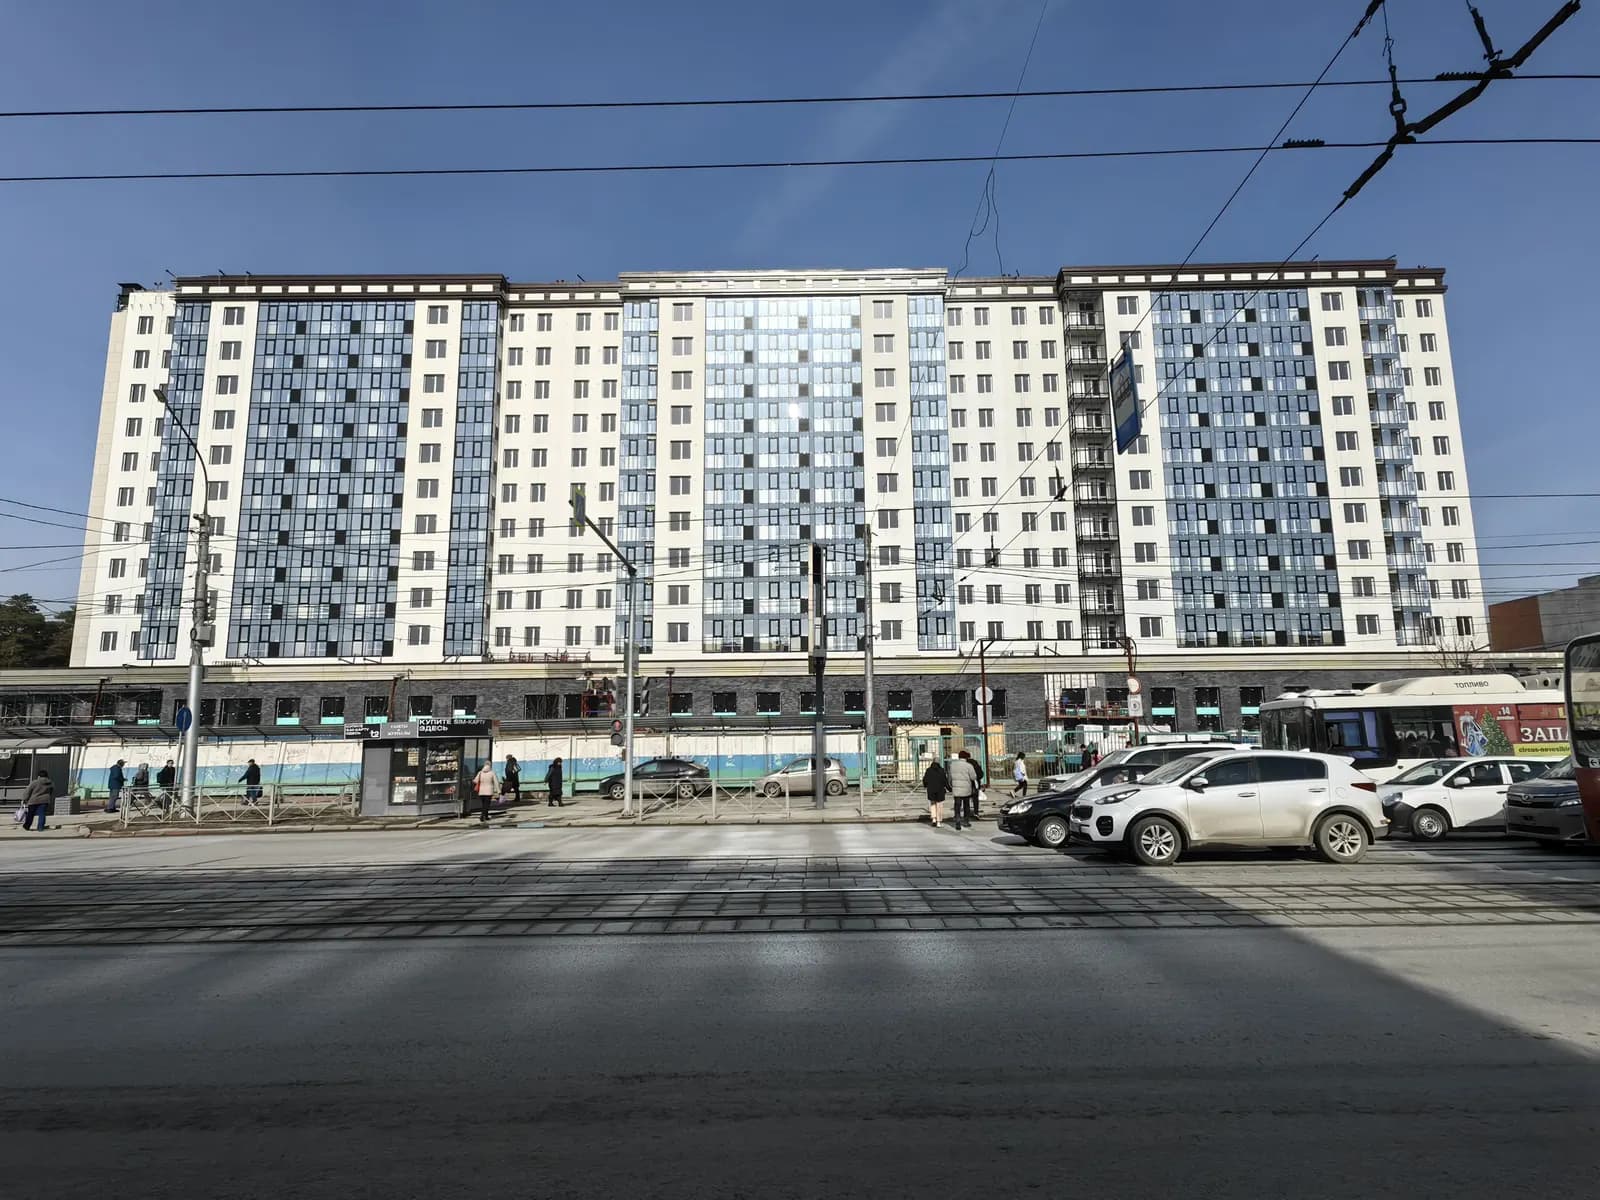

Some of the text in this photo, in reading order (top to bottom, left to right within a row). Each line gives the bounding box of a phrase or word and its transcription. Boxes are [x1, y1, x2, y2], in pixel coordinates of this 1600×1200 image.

[1453, 680, 1489, 689] ТОПЛИВО
[419, 725, 449, 733] ЗДЕСЬ
[1520, 727, 1569, 742] ЗАП
